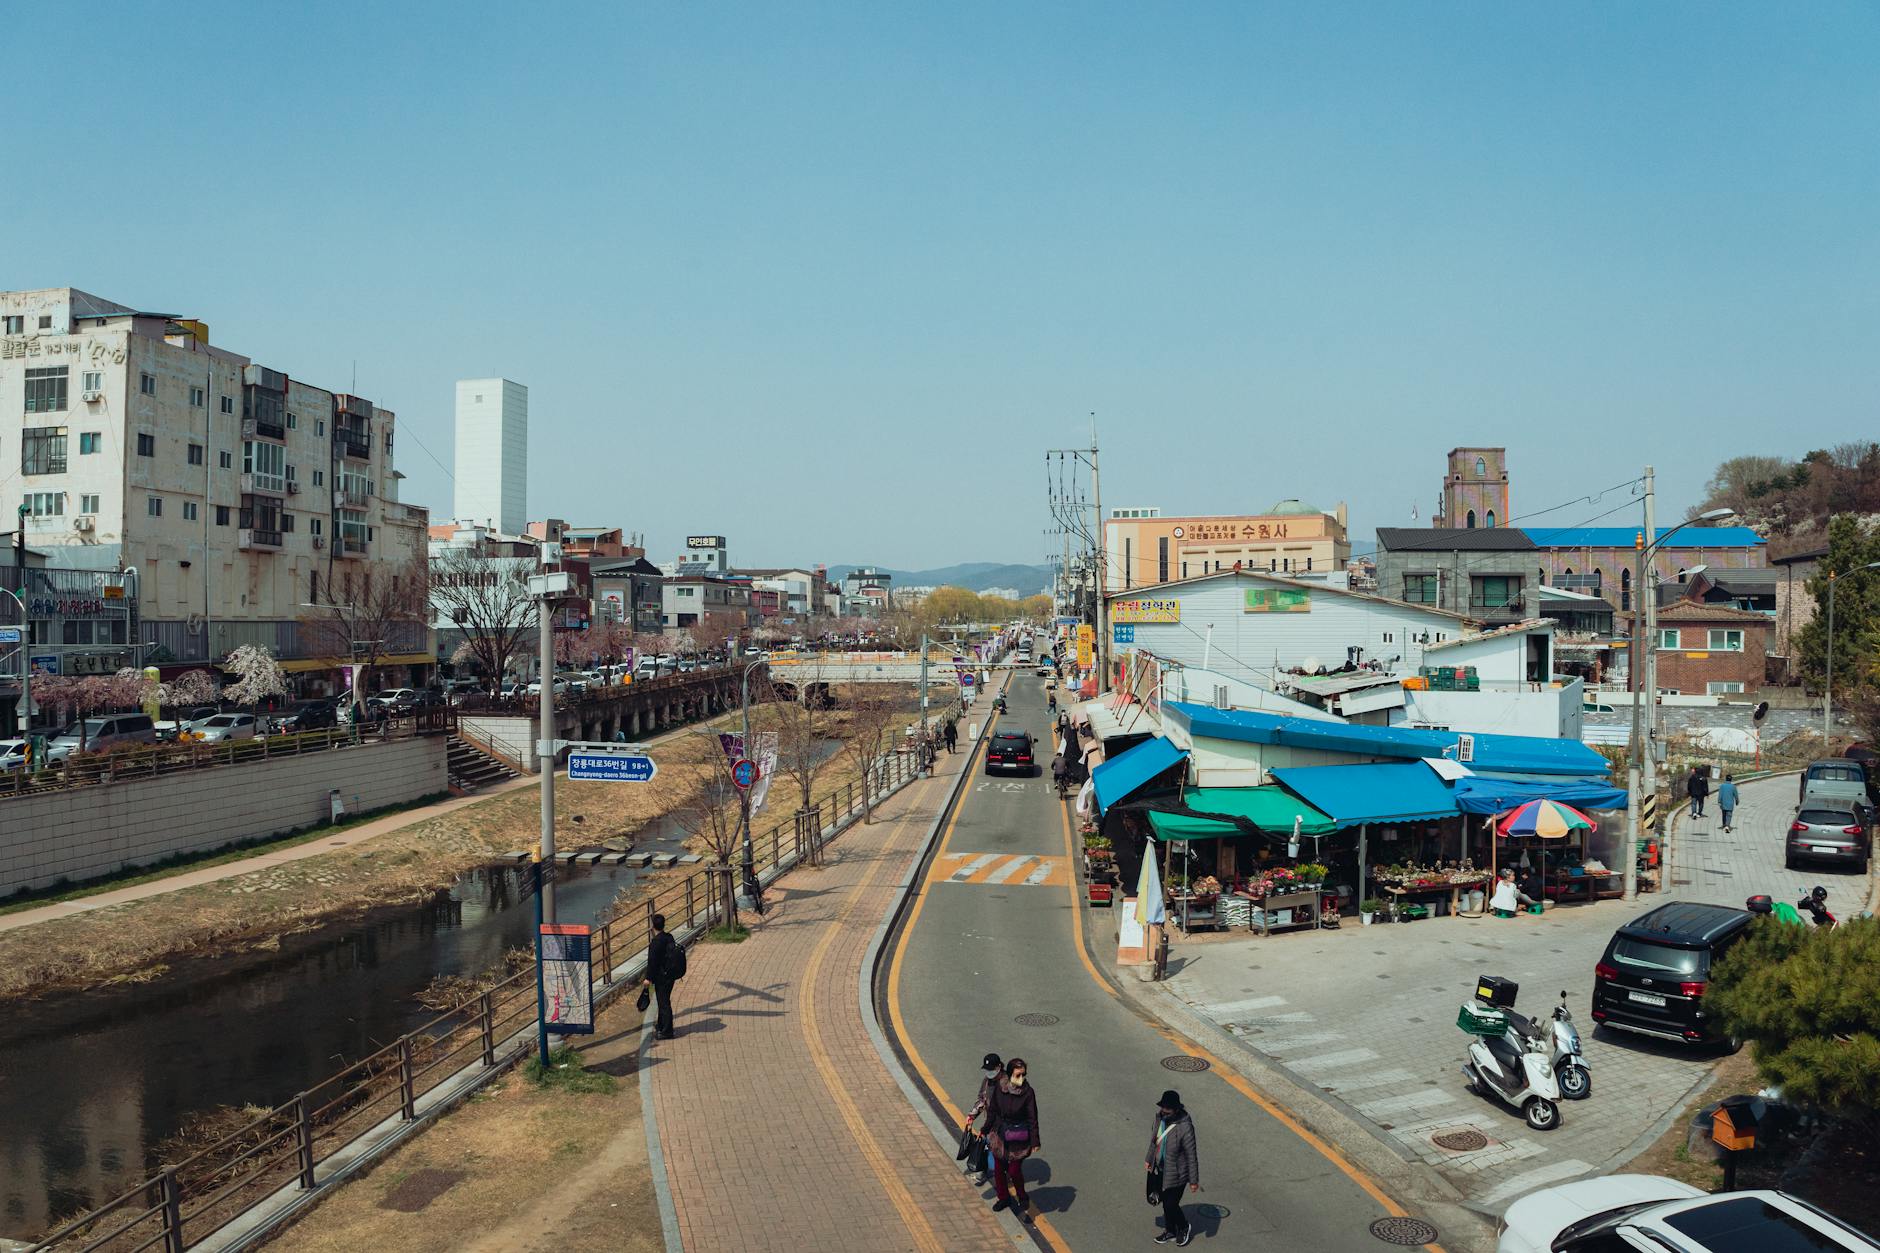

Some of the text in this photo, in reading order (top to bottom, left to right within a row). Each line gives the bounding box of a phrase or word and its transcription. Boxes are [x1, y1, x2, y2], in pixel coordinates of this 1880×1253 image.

[1242, 524, 1287, 539] 수원사
[688, 537, 716, 546] 무인호텔
[572, 759, 627, 770] 창룡대로36번길
